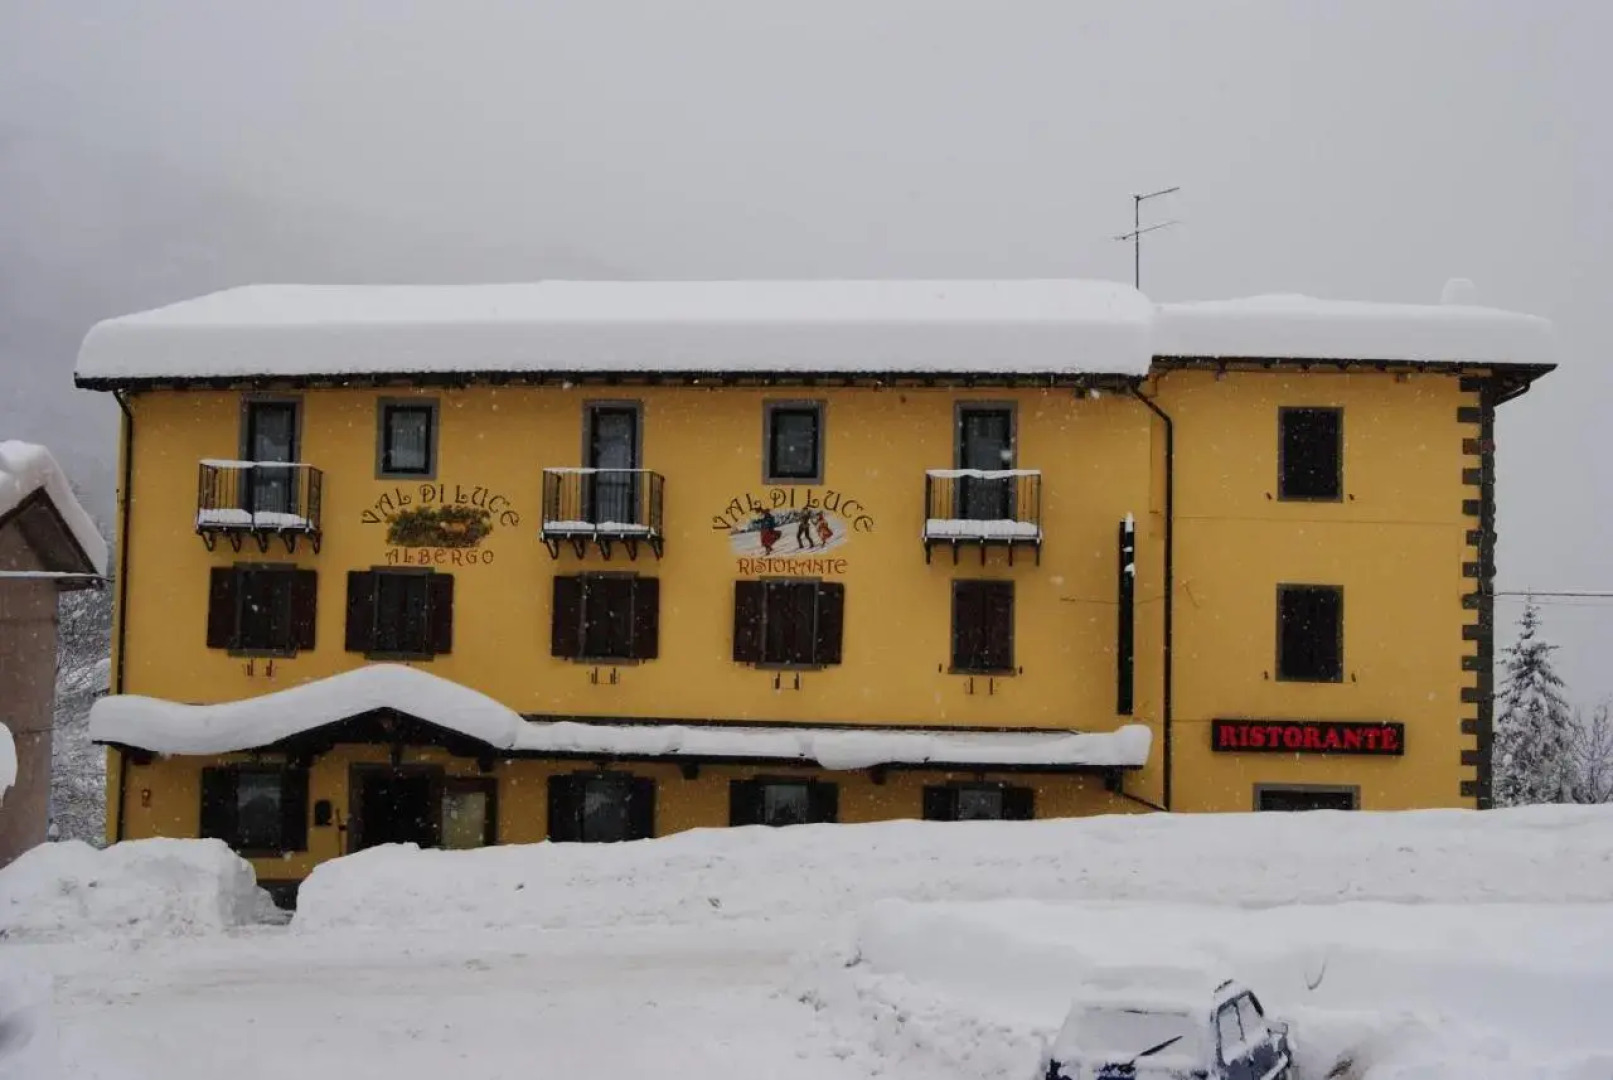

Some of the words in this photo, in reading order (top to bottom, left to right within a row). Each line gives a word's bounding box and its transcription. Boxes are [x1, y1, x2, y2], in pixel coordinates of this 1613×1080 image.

[361, 488, 412, 524] VAL
[420, 484, 444, 503] DI
[455, 485, 519, 527] LUCE
[712, 493, 763, 530] VAL
[770, 488, 795, 507] DI
[806, 489, 874, 532] LUCE
[385, 549, 494, 565] ALBERGO
[737, 557, 849, 575] RISTORANTE
[1219, 725, 1398, 750] RISTORANTE
